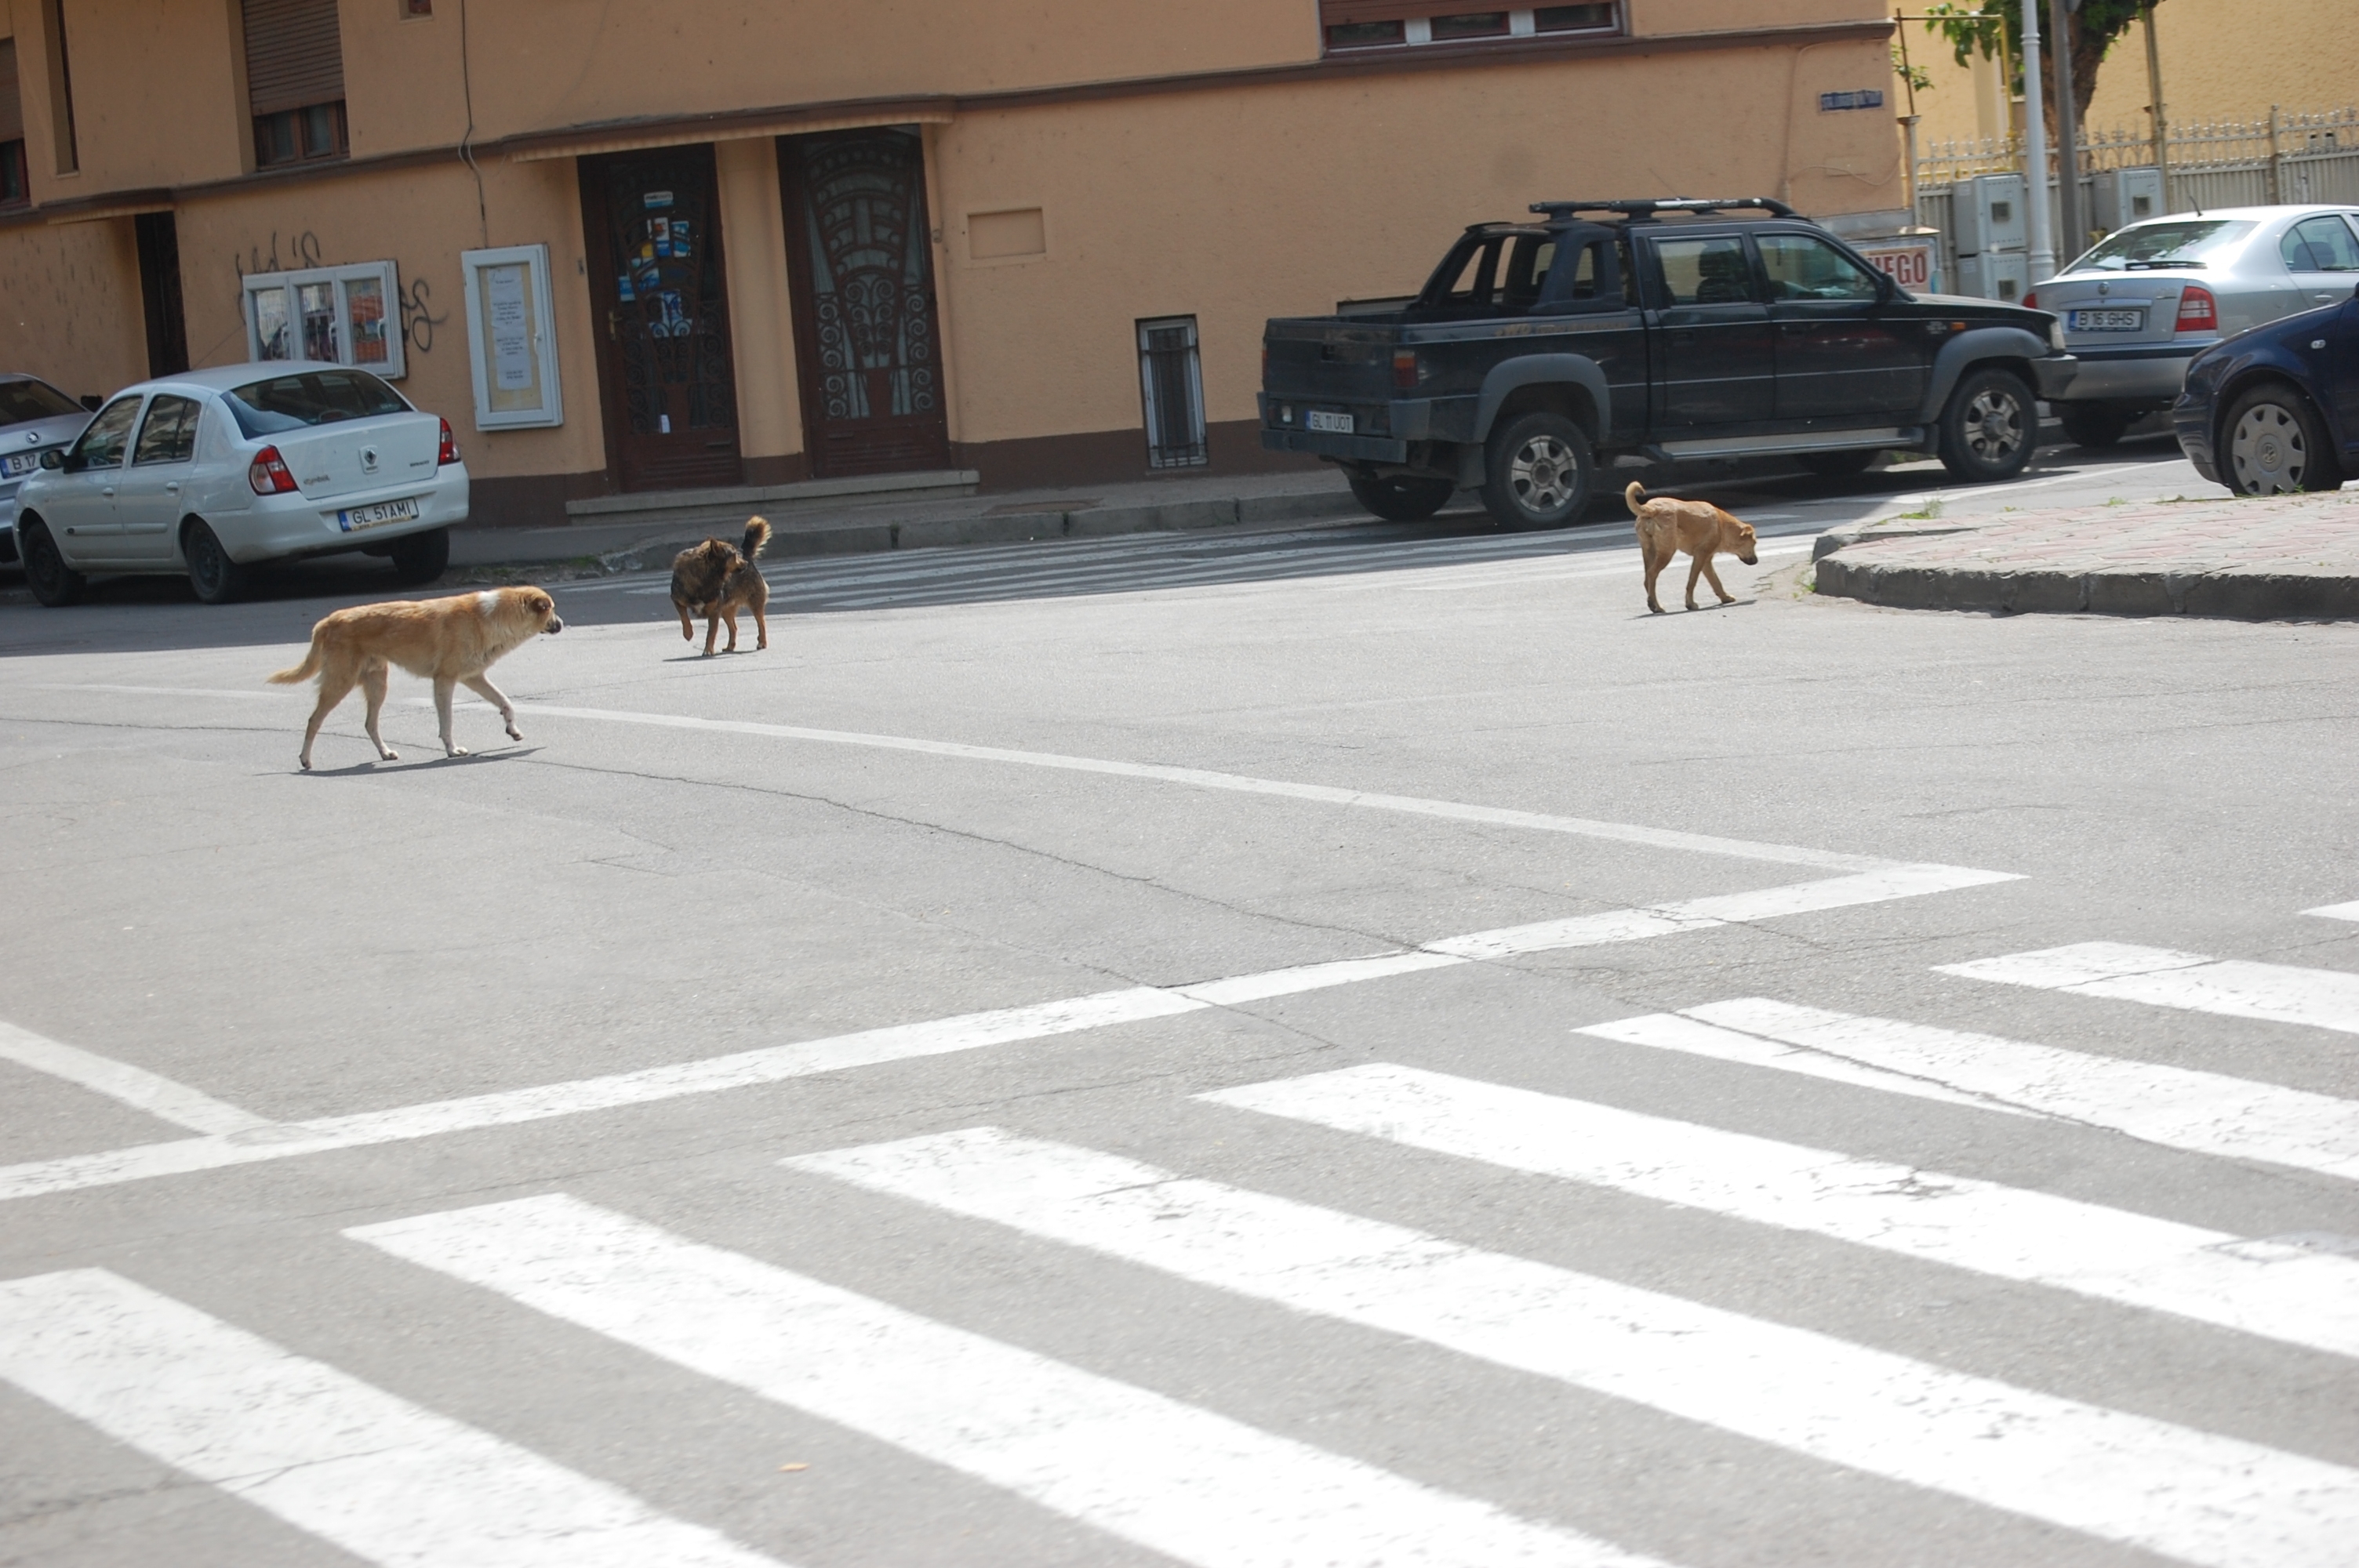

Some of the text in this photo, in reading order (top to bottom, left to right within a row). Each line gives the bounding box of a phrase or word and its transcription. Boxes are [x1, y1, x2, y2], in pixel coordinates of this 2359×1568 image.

[2079, 313, 2088, 325] B
[2108, 313, 2134, 326] GHS
[1313, 414, 1323, 429] GL
[12, 454, 36, 470] B 17
[352, 510, 371, 524] GL
[373, 506, 388, 520] 51
[390, 501, 411, 517] AMI
